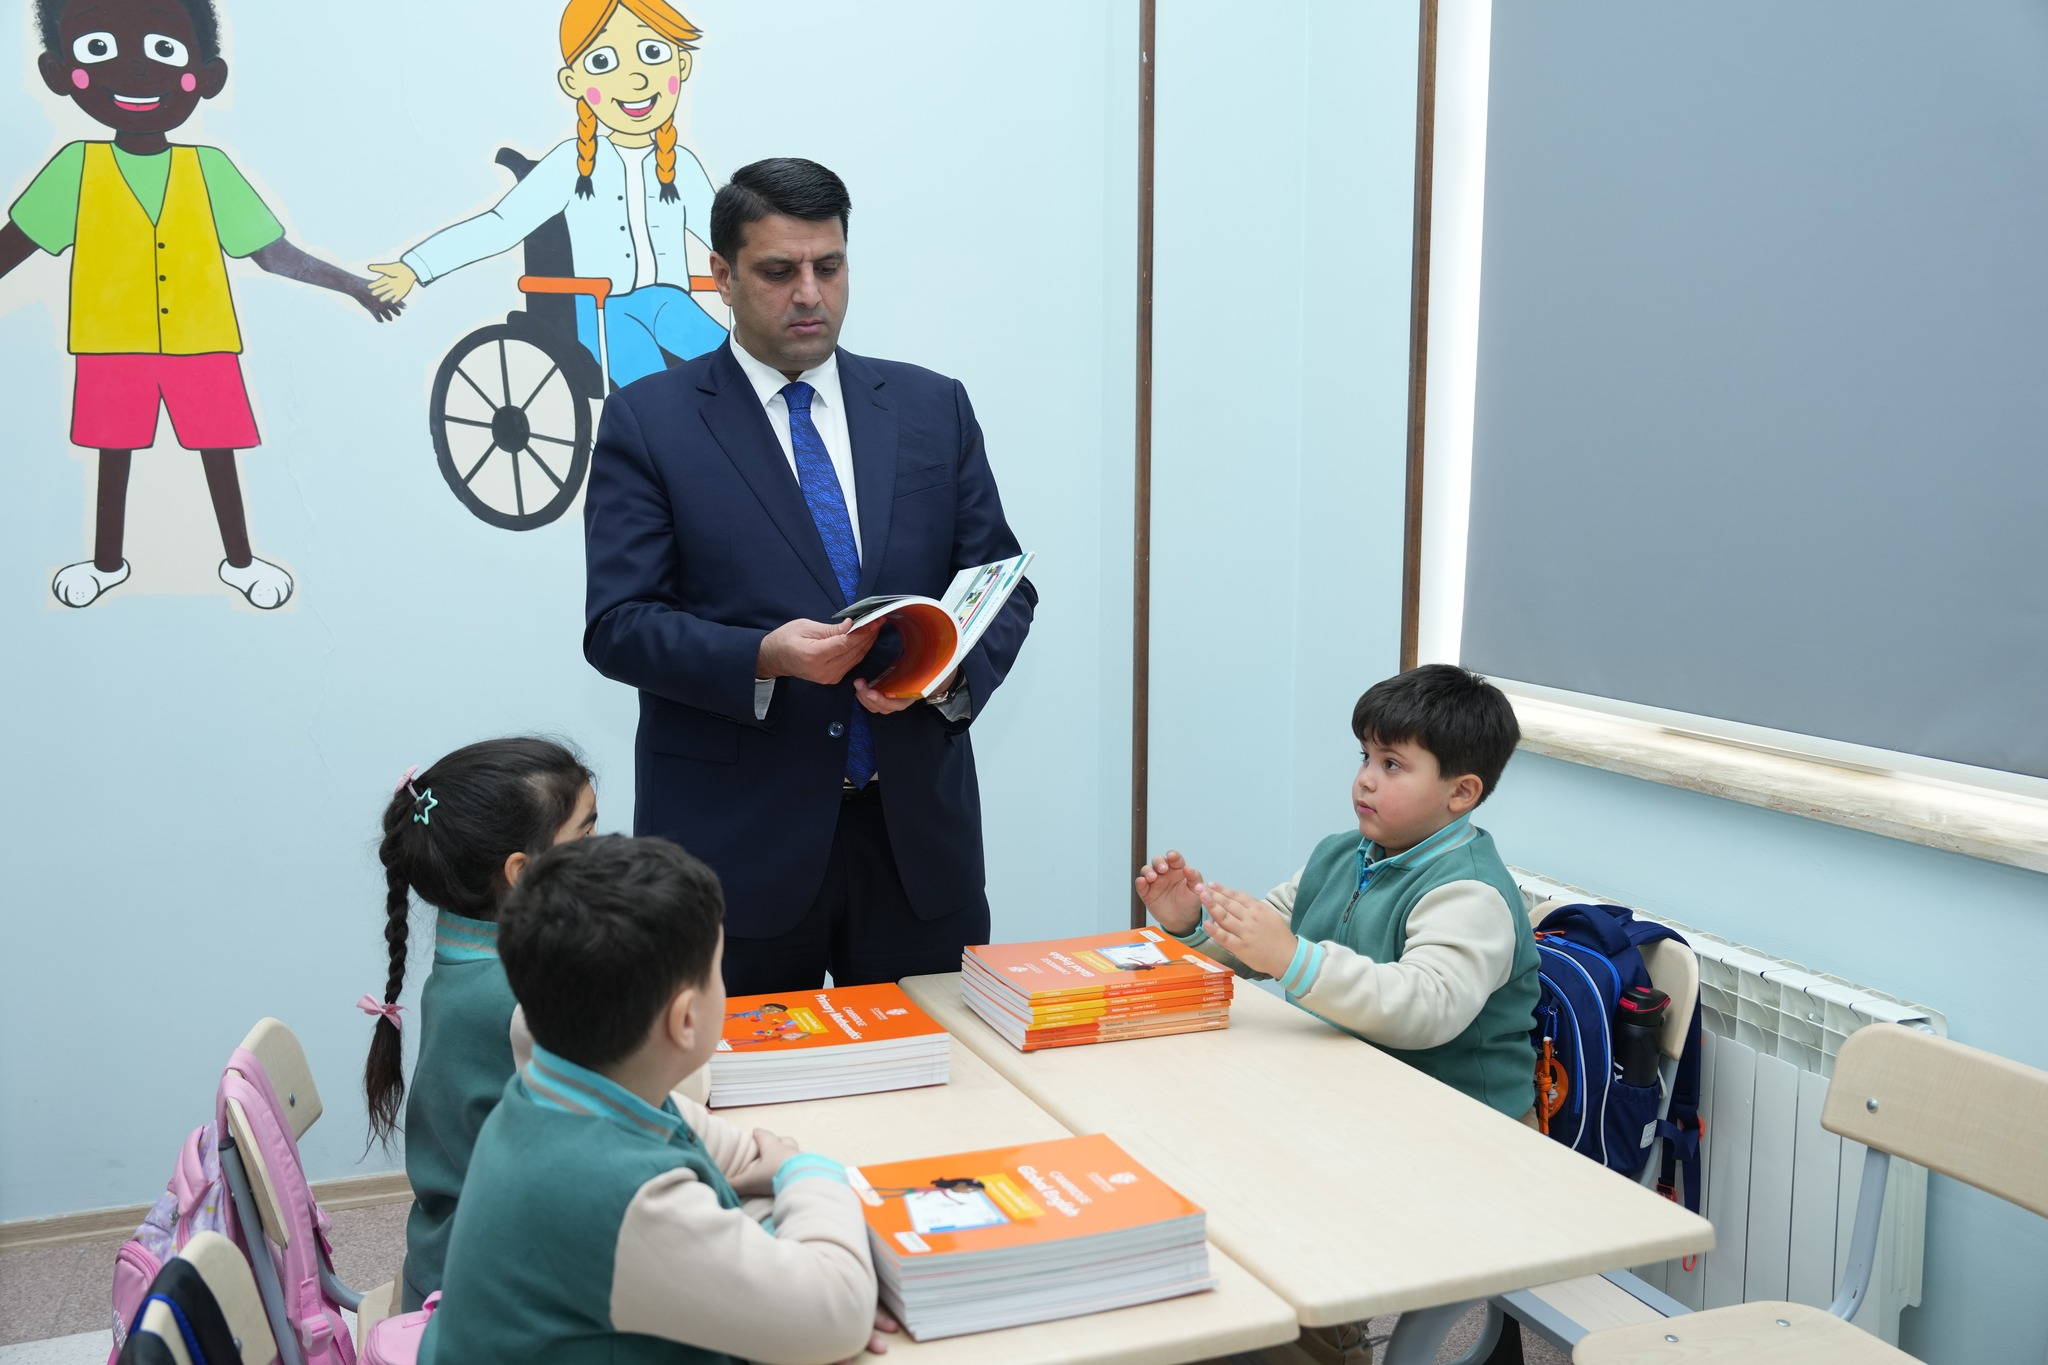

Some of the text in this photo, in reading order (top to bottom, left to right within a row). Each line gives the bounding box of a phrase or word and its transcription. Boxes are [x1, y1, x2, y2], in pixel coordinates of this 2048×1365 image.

[1048, 951, 1075, 967] English
[1067, 963, 1095, 978] Global
[814, 993, 862, 1040] Primary Mathematics
[842, 1006, 868, 1027] CAMBRIDGE
[1016, 1164, 1056, 1194] Global
[1042, 1188, 1081, 1217] English
[1049, 1170, 1094, 1205] CAMBRIDGE
